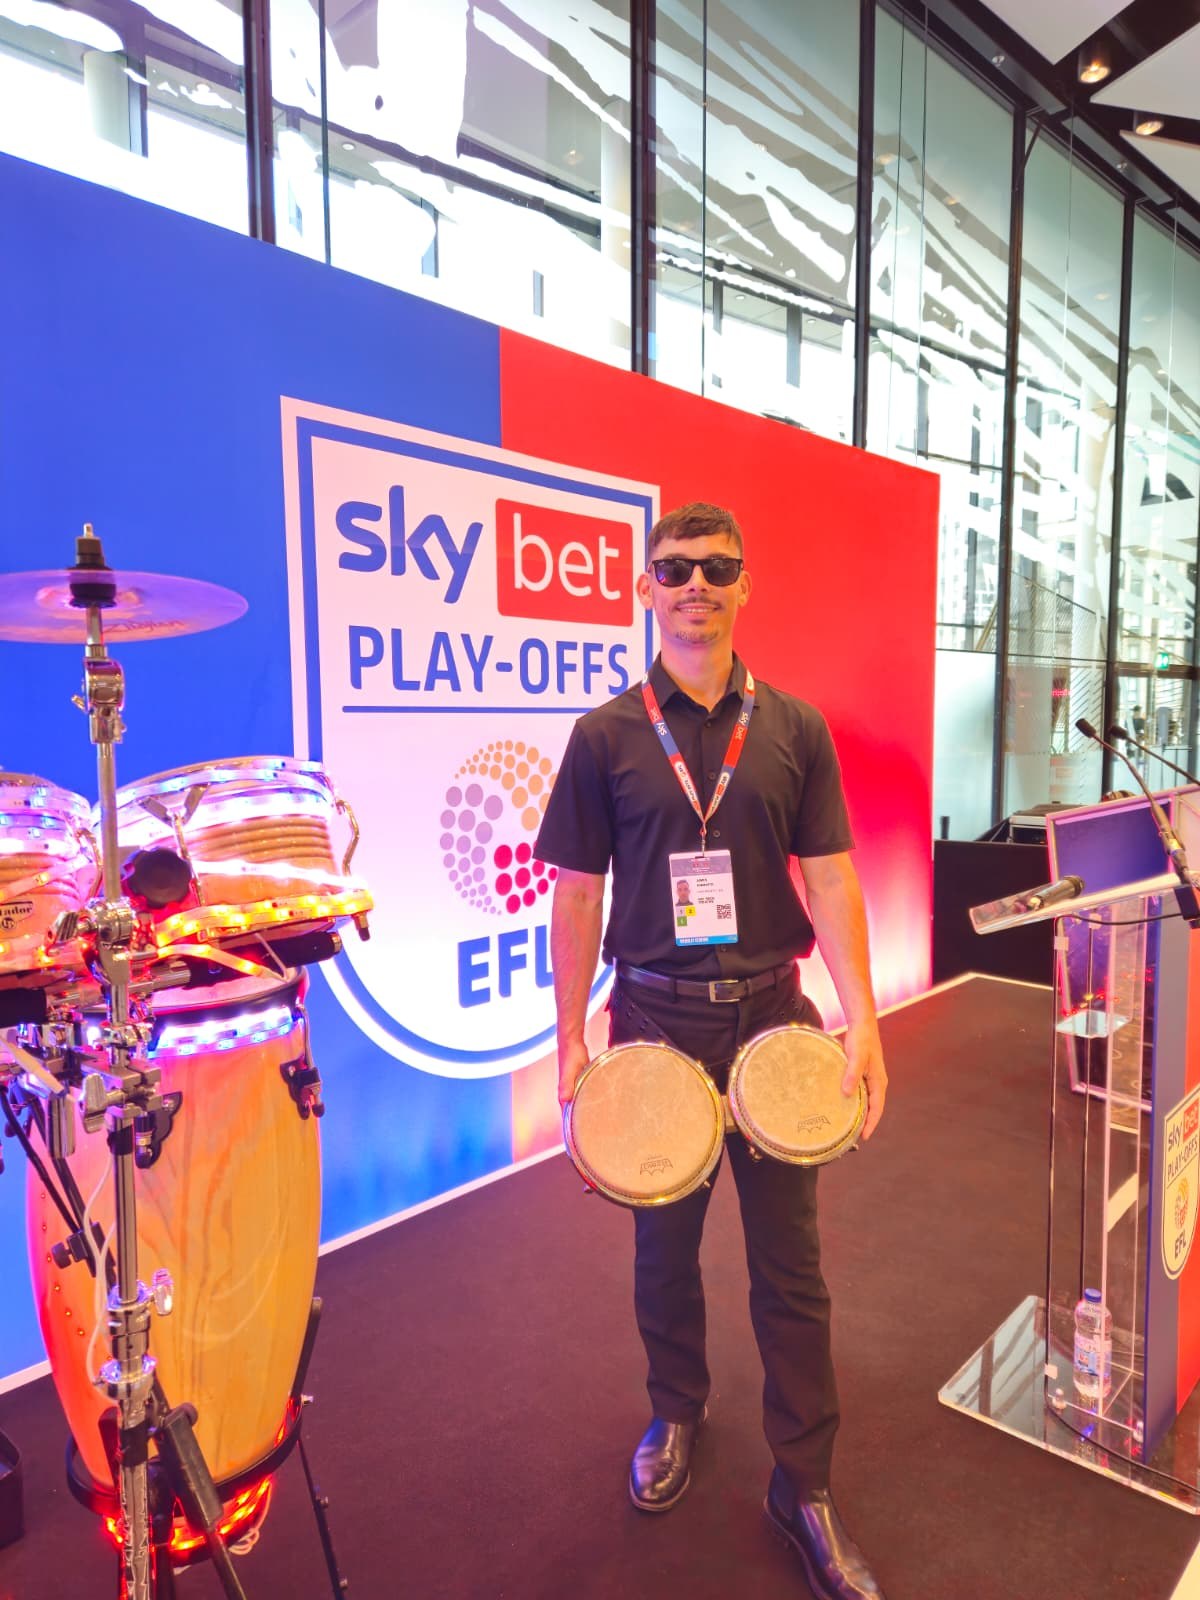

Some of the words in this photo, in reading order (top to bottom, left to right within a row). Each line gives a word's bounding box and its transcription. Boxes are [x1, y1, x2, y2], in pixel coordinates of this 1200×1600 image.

[335, 484, 484, 604] sky
[513, 512, 621, 600] bet
[348, 625, 629, 695] PLAY-OFFS
[457, 924, 555, 1008] EFL
[1174, 1228, 1187, 1260] EFL
